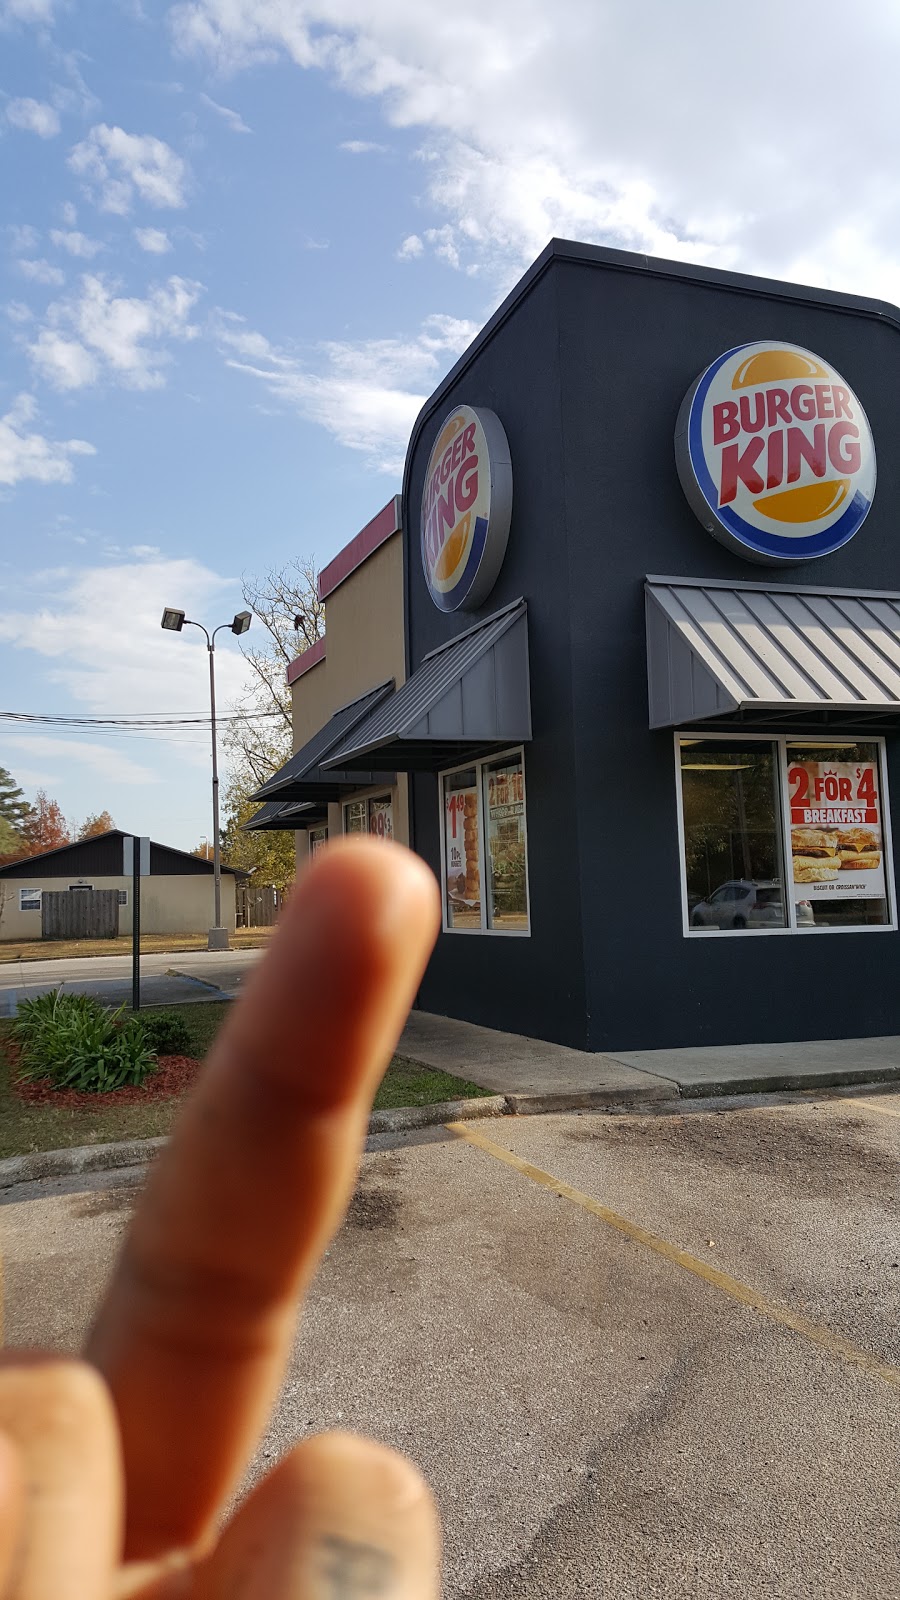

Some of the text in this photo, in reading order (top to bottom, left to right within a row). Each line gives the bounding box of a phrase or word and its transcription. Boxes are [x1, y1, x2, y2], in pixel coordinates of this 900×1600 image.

[712, 384, 854, 446] BURGER
[719, 420, 862, 507] KING
[787, 767, 811, 808] 2
[814, 776, 853, 802] FOR
[803, 808, 867, 824] BREAKFAST
